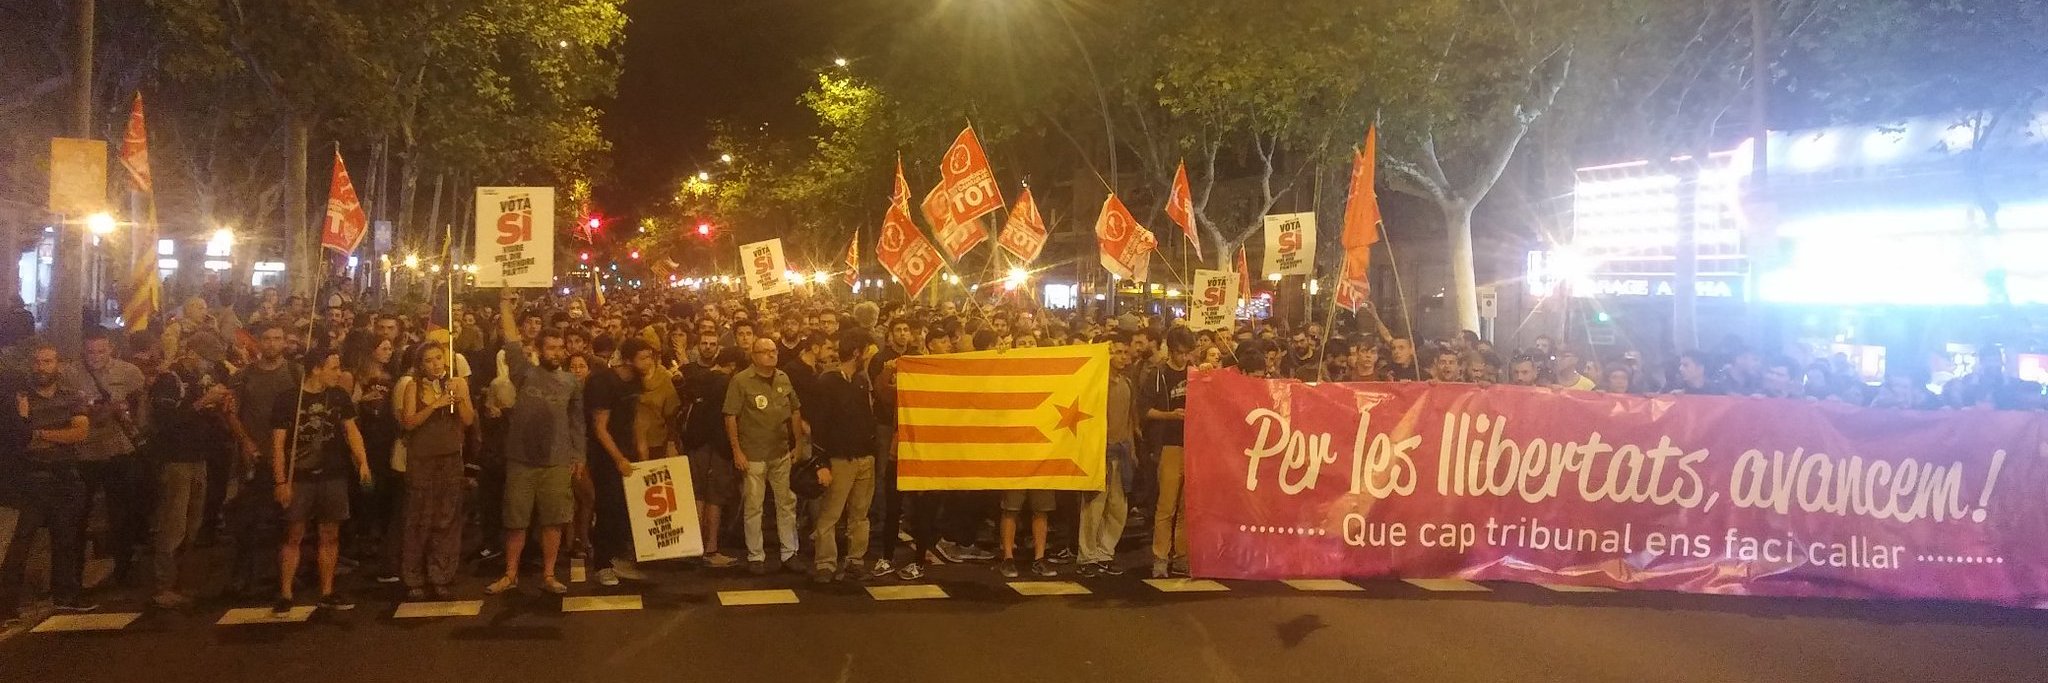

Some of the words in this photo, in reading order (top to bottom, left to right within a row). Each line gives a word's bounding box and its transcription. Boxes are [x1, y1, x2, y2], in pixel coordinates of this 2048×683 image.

[500, 197, 531, 213] VOTA
[953, 177, 994, 214] TOT
[1279, 220, 1301, 232] VOTA
[752, 246, 770, 257] VOTA
[901, 243, 934, 286] TOT
[1207, 279, 1226, 287] VOTA
[1244, 408, 1337, 495] Per
[1350, 410, 1422, 499] les
[1437, 411, 1720, 513] llibertats,
[1730, 447, 2007, 523] avancem!
[643, 468, 672, 487] VOTA
[1342, 513, 1407, 548] Que
[1419, 521, 1476, 554] cap
[1485, 516, 1633, 554] tribunal
[1646, 530, 1711, 558] ens
[1725, 527, 1793, 563] faci
[1808, 535, 1906, 569] callar
